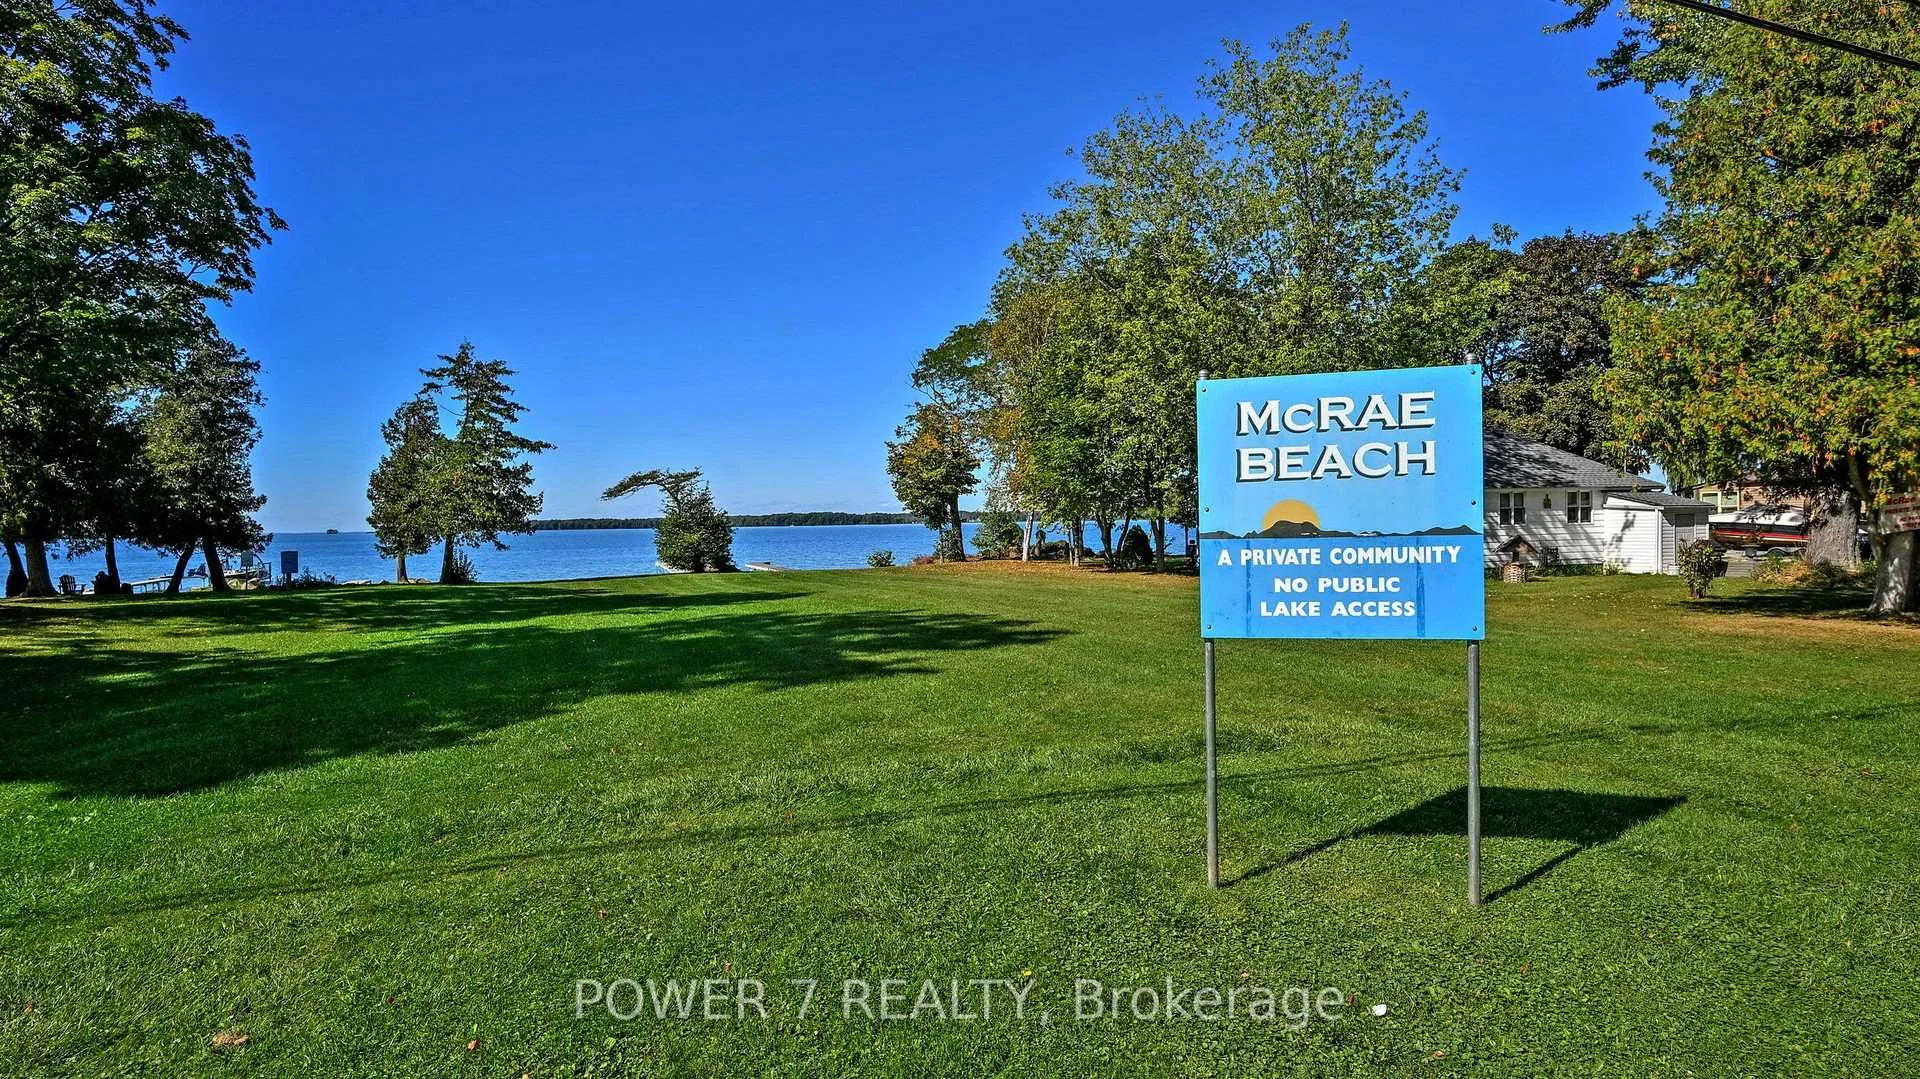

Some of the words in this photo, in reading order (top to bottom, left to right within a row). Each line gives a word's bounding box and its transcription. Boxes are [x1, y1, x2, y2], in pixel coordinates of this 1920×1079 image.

[1236, 440, 1436, 483] BEACH
[1217, 548, 1233, 566] A
[1240, 547, 1321, 566] PRIVATE
[1329, 545, 1462, 565] COMMUNITY
[1274, 577, 1308, 593] NO
[1318, 576, 1401, 593] PUBLIC
[1260, 601, 1321, 617] LAKE
[1330, 601, 1416, 617] ACCESS
